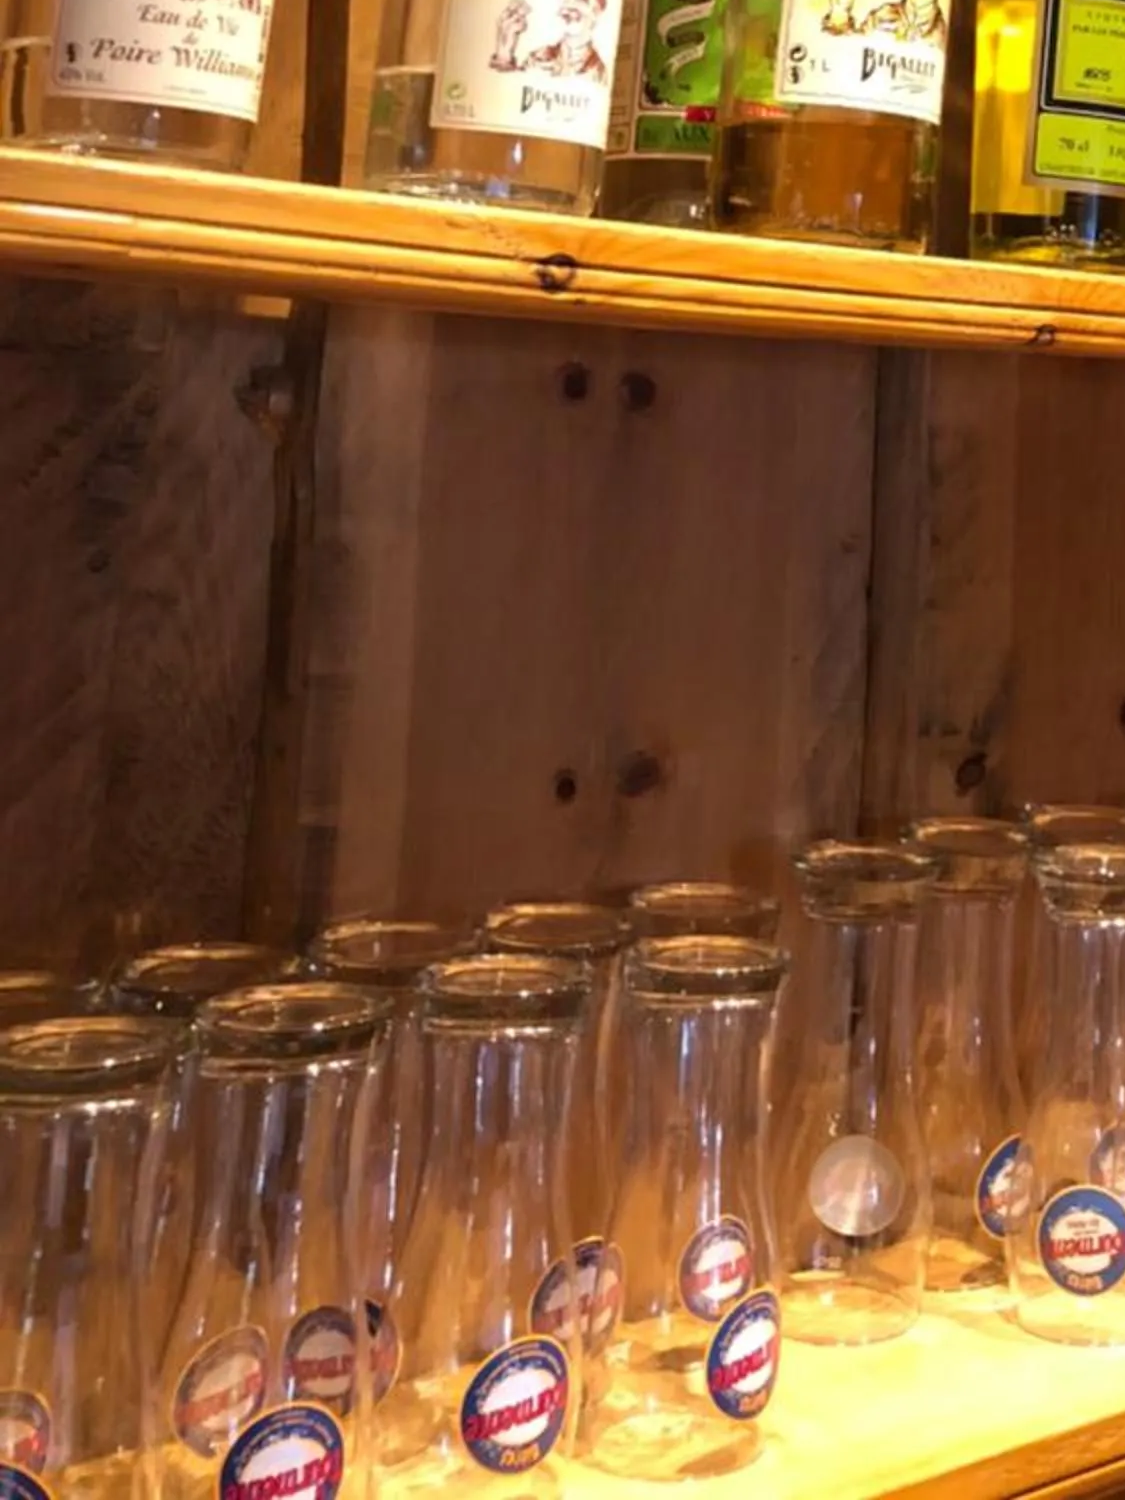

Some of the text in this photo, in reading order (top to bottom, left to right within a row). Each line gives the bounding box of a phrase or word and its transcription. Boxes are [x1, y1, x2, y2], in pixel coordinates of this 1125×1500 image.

[137, 3, 181, 25] Eau
[186, 10, 208, 31] de
[90, 37, 163, 67] Poire
